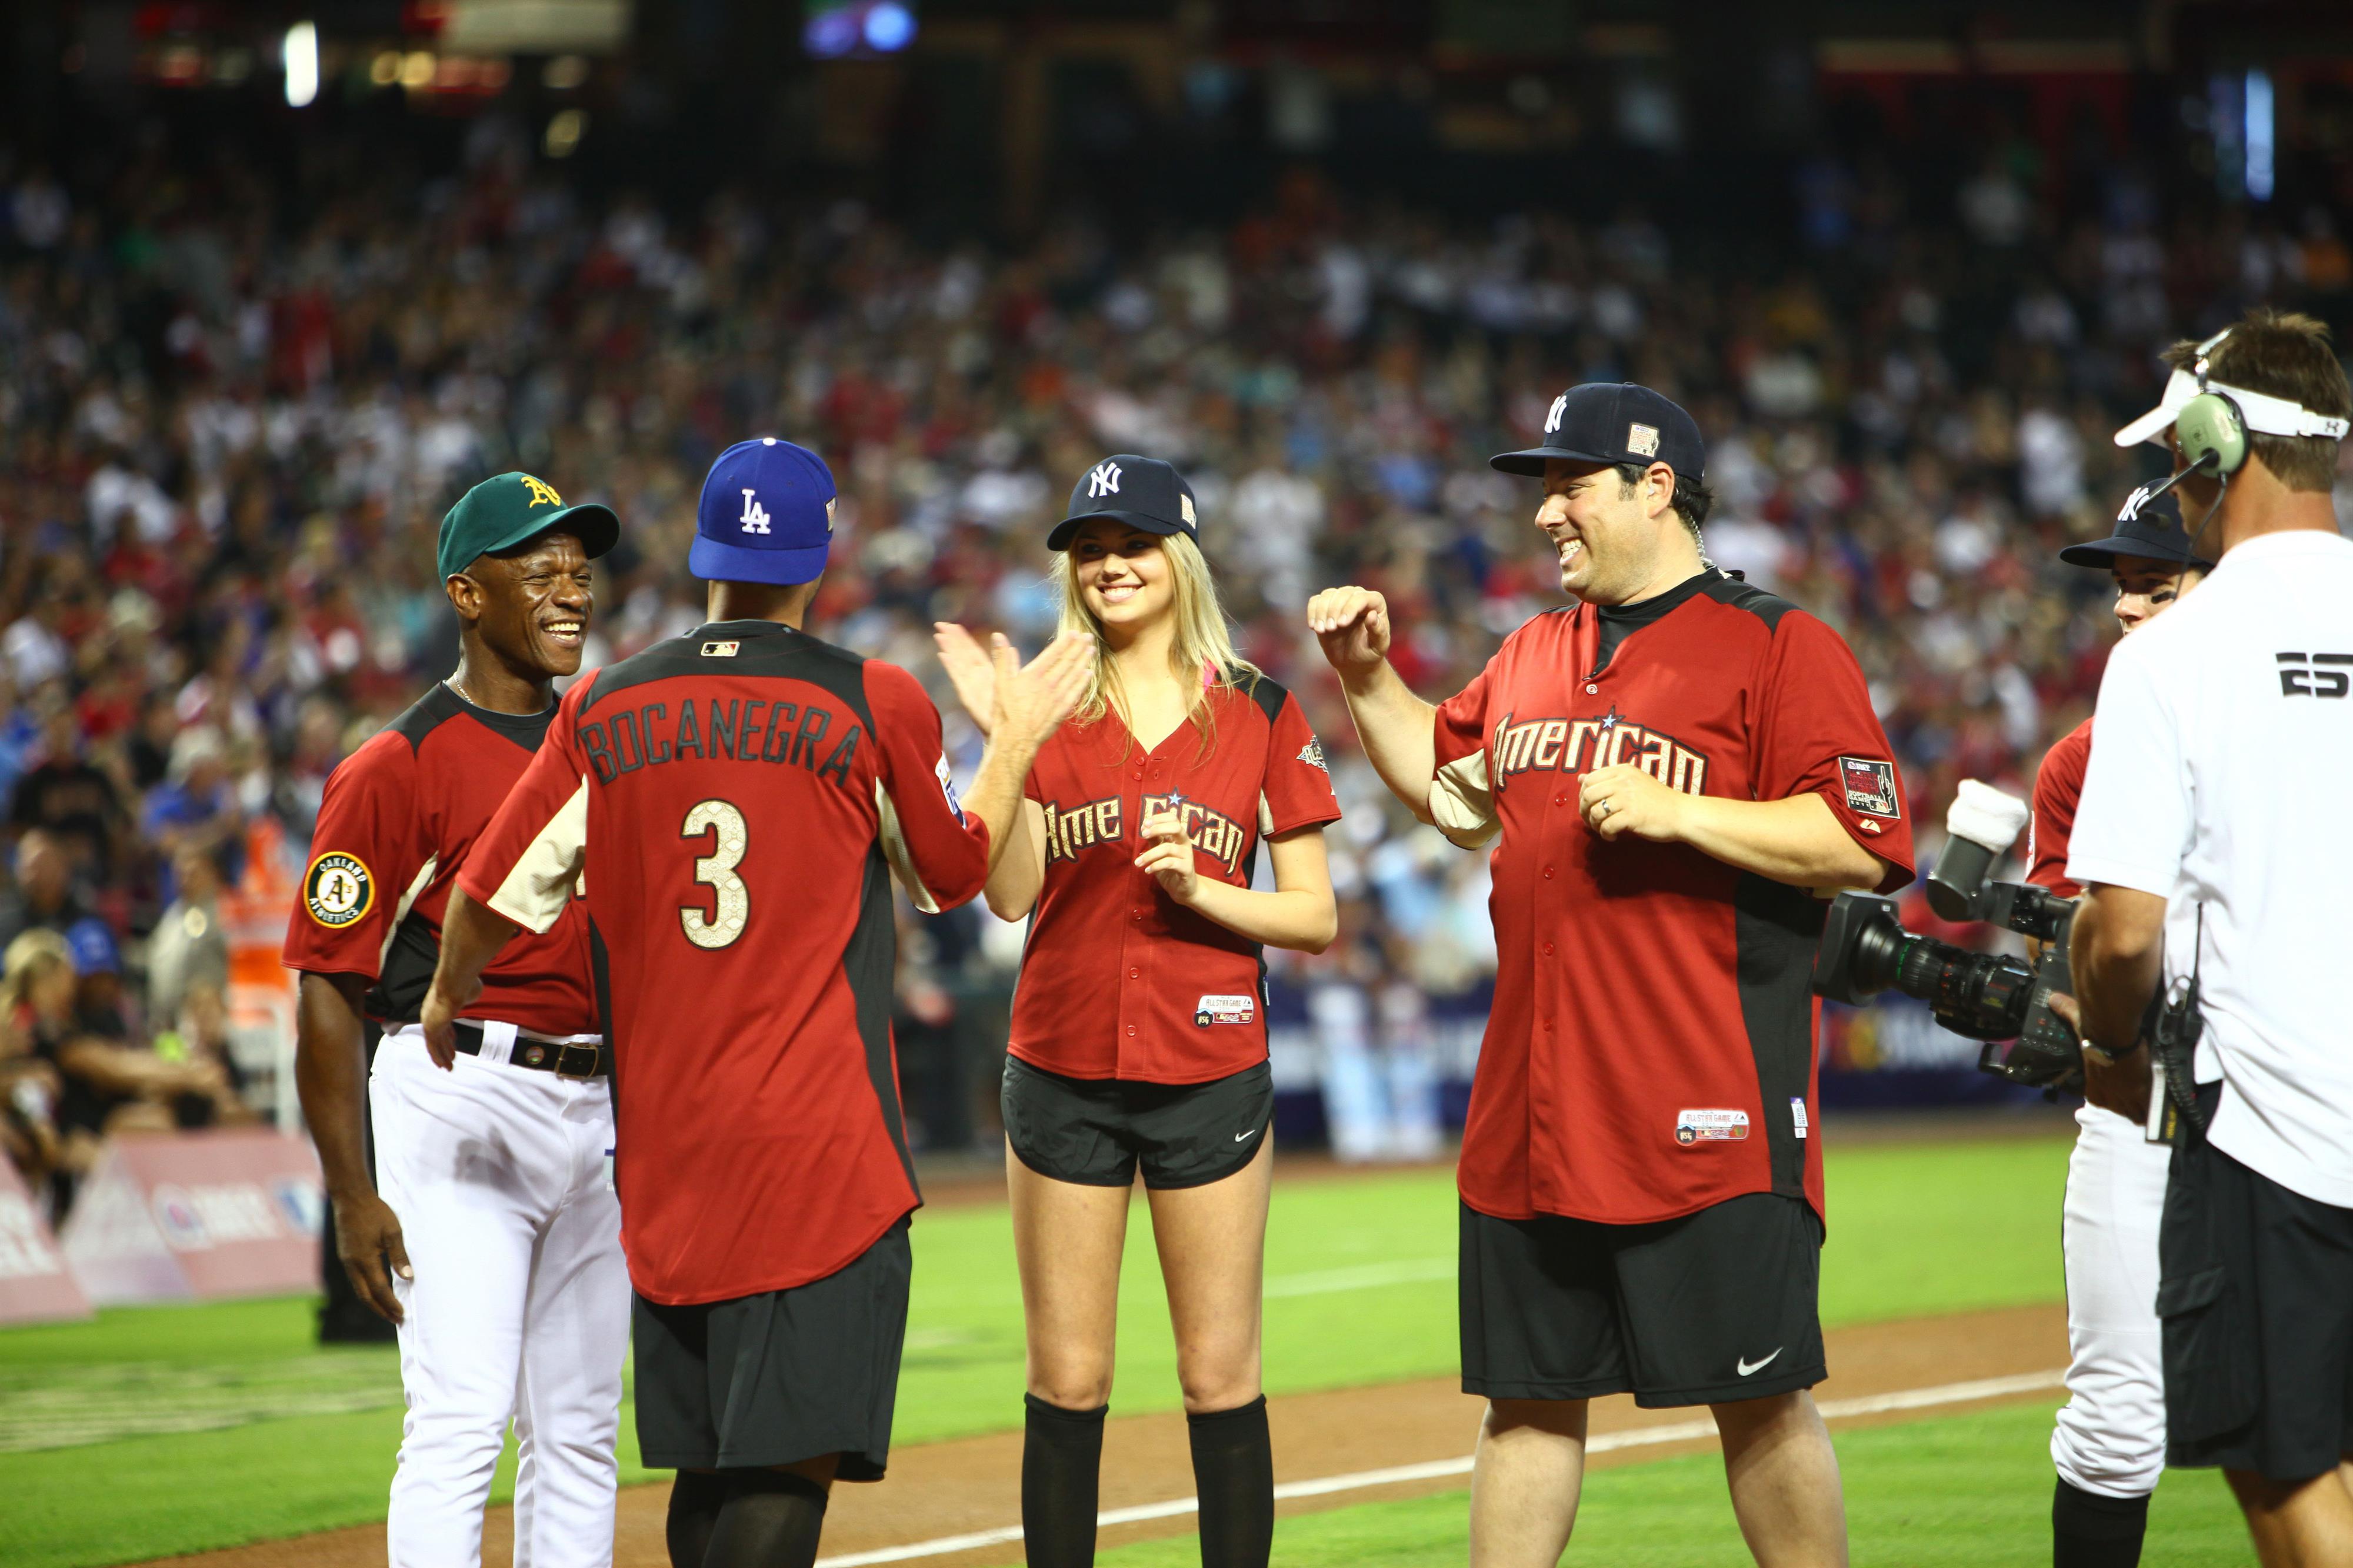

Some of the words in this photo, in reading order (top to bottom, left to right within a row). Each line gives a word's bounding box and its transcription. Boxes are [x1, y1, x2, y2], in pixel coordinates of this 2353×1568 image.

[1088, 462, 1123, 498] NY
[739, 488, 772, 535] LA
[2275, 652, 2353, 699] ES
[577, 698, 862, 788] BOCANEGRA
[319, 858, 368, 882] OAKLAND
[679, 798, 749, 951] 3
[309, 897, 359, 923] ATHLETICS
